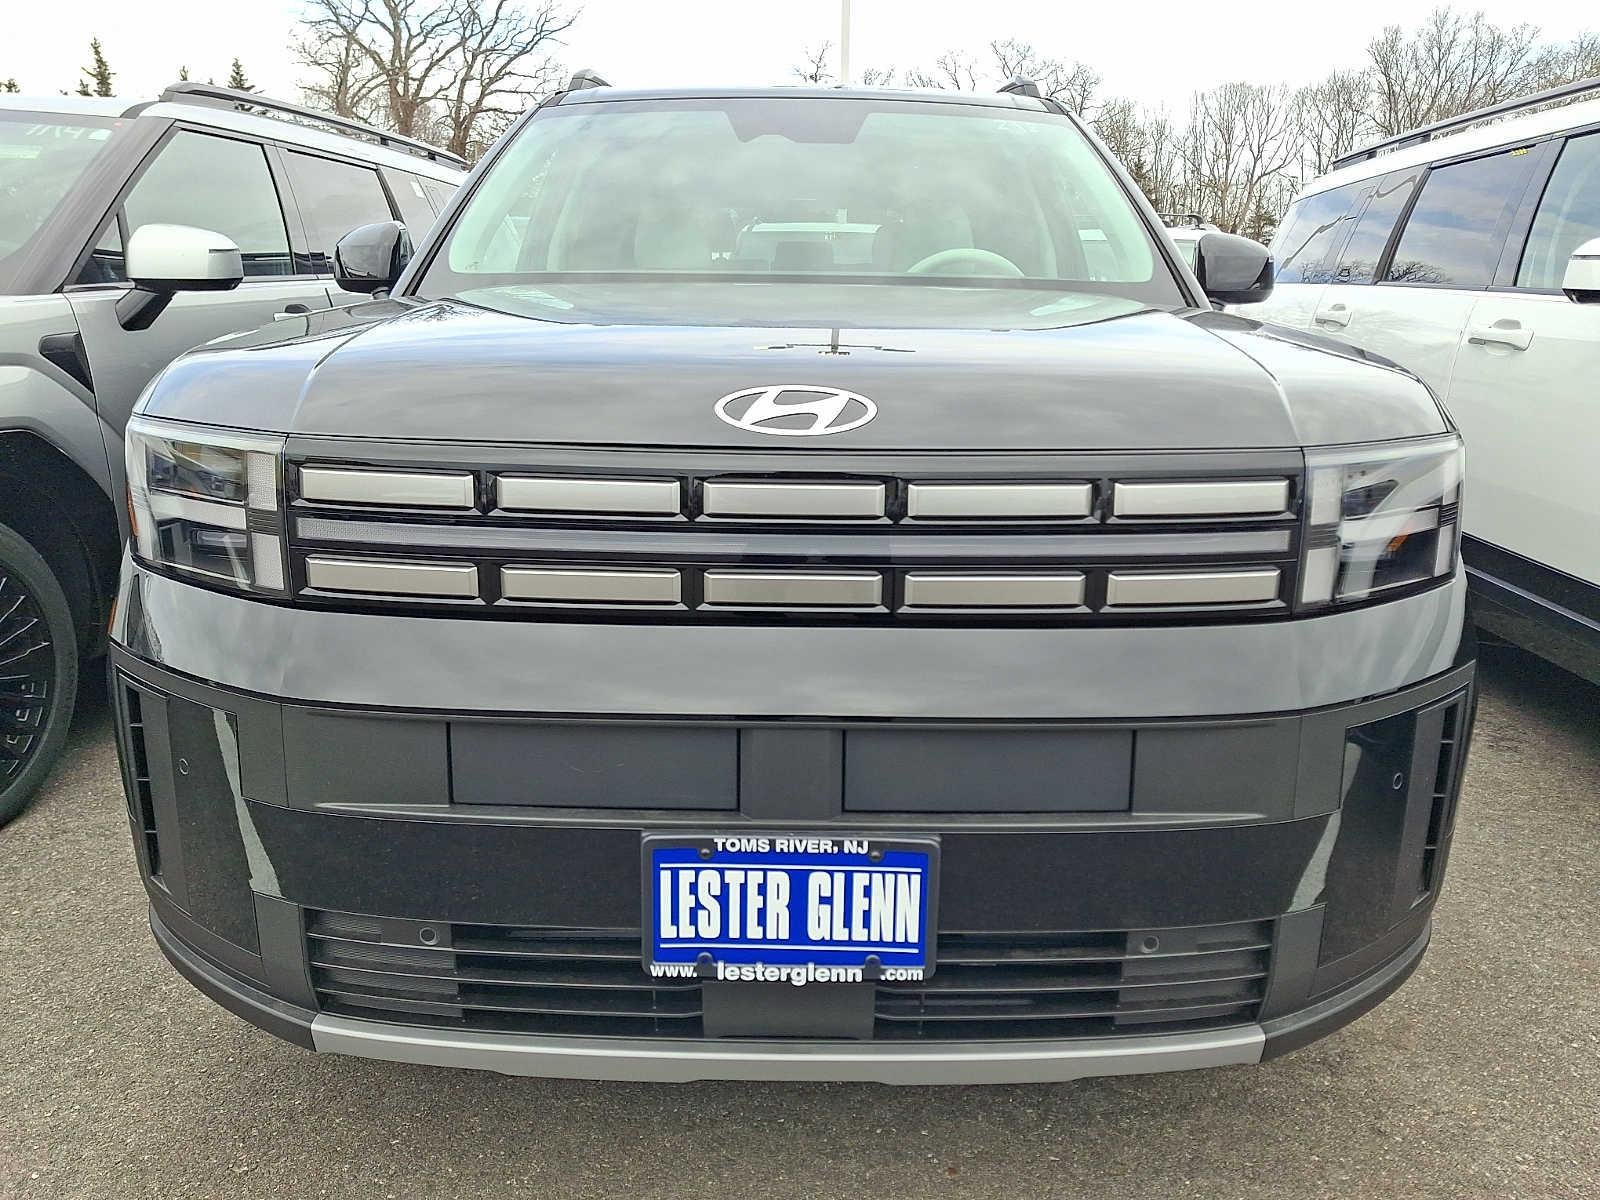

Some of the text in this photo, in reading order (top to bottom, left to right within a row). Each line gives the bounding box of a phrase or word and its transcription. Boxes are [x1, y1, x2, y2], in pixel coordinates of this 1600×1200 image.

[714, 838, 869, 855] TOMS RIVER, NJ
[660, 869, 921, 943] LESTER GLENN
[650, 961, 924, 986] www. lesterglenn .com
